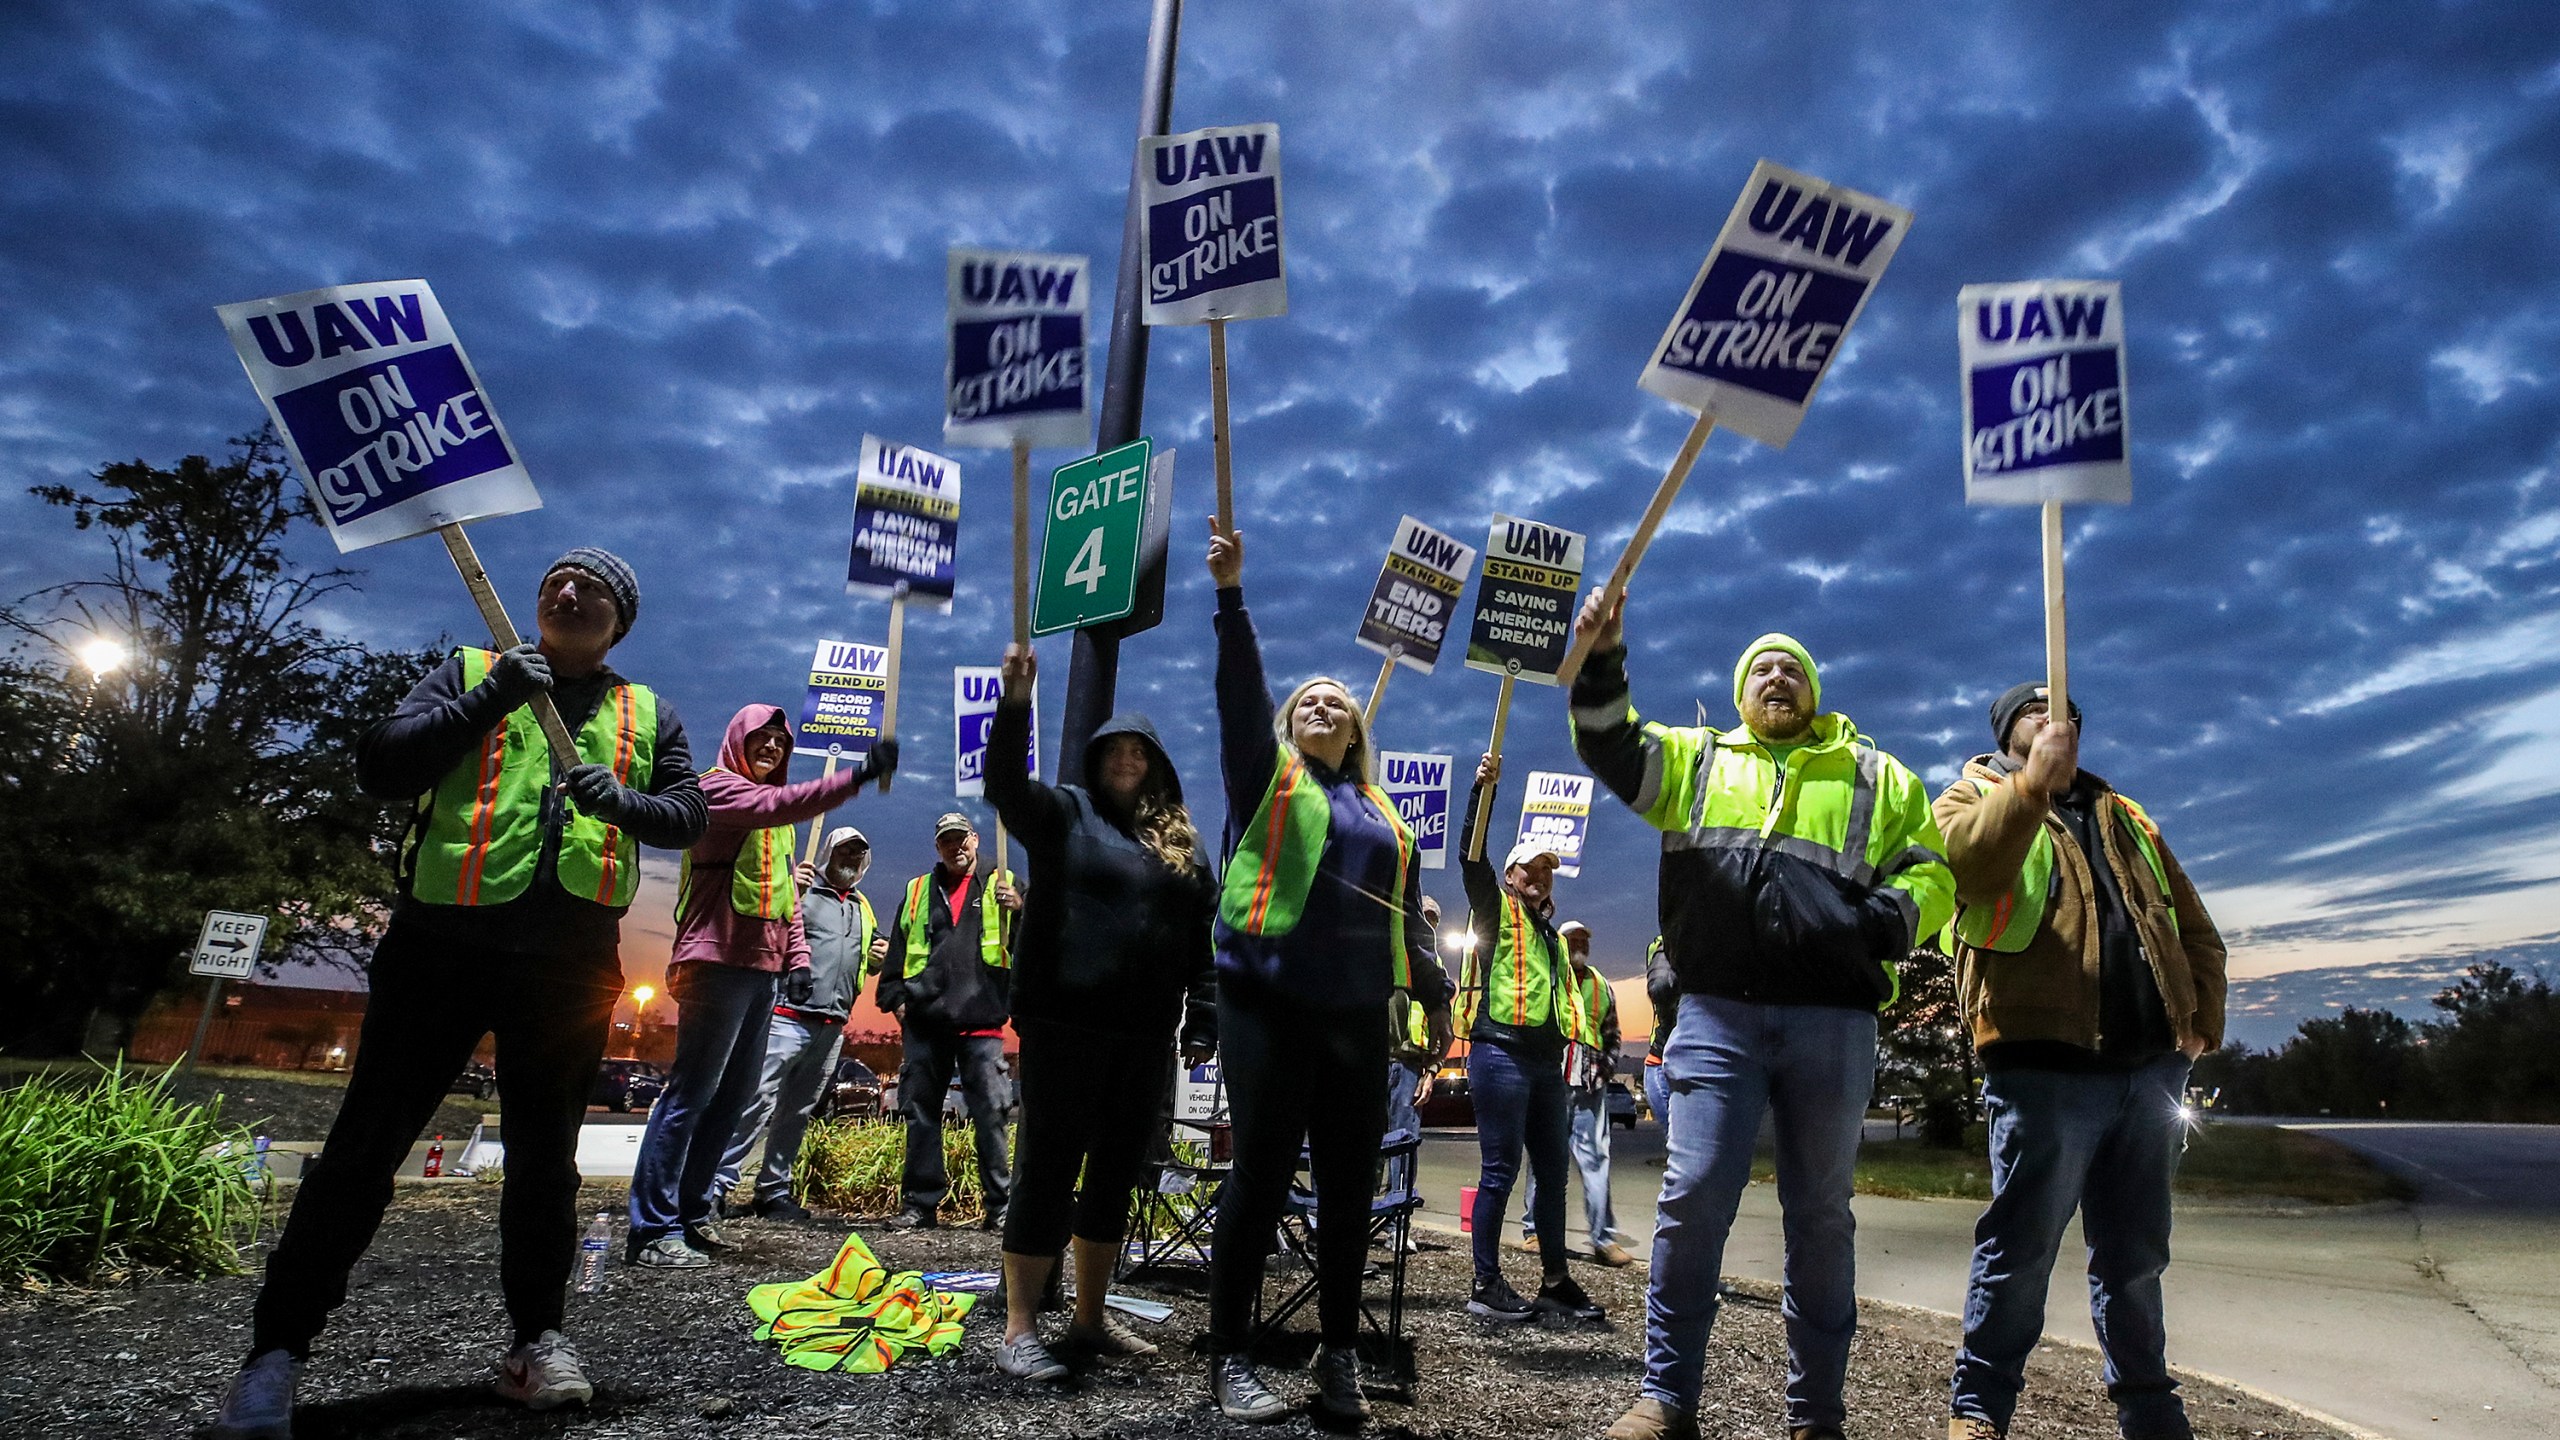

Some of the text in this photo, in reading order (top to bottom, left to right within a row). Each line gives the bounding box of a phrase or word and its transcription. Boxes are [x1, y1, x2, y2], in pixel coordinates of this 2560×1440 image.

[1155, 134, 1265, 185] UAW
[1184, 190, 1232, 242] ON
[1749, 178, 1895, 268] UAW
[1152, 215, 1277, 300] STRIKE
[961, 262, 1079, 306] UAW
[1736, 269, 1814, 320] ON
[246, 294, 428, 367] UAW
[988, 314, 1041, 369] ON
[1979, 295, 2108, 345] UAW
[1664, 318, 1842, 371] STRIKE
[338, 364, 417, 434] ON
[951, 346, 1082, 419] STRIKE
[2010, 352, 2071, 415] ON
[1971, 387, 2121, 472] STRIKE
[318, 390, 493, 518] STRIKE
[878, 445, 945, 490] UAW
[1055, 465, 1140, 521] GATE
[1064, 526, 1107, 595] 4
[1406, 526, 1463, 572] UAW
[1505, 521, 1571, 566] UAW
[1392, 559, 1458, 592] STAND UP
[1489, 562, 1574, 588] STAND UP
[1374, 597, 1444, 642] TIERS
[1388, 580, 1442, 616] END
[1494, 589, 1557, 613] SAVING
[1477, 608, 1567, 636] AMERICAN
[1489, 626, 1550, 649] DREAM
[814, 674, 885, 688] STAND UP
[828, 645, 884, 673] UAW
[817, 702, 871, 715] PROFITS
[819, 692, 873, 705] RECORD
[963, 677, 1002, 702] UA
[801, 723, 877, 738] CONTRACTS
[814, 713, 868, 726] RECORD
[1387, 759, 1446, 786] UAW
[1539, 777, 1582, 798] UAW
[1399, 793, 1425, 820] ON
[1530, 816, 1575, 835] END
[211, 920, 256, 936] KEEP
[197, 952, 250, 969] RIGHT
[1188, 1106, 1197, 1114] ON
